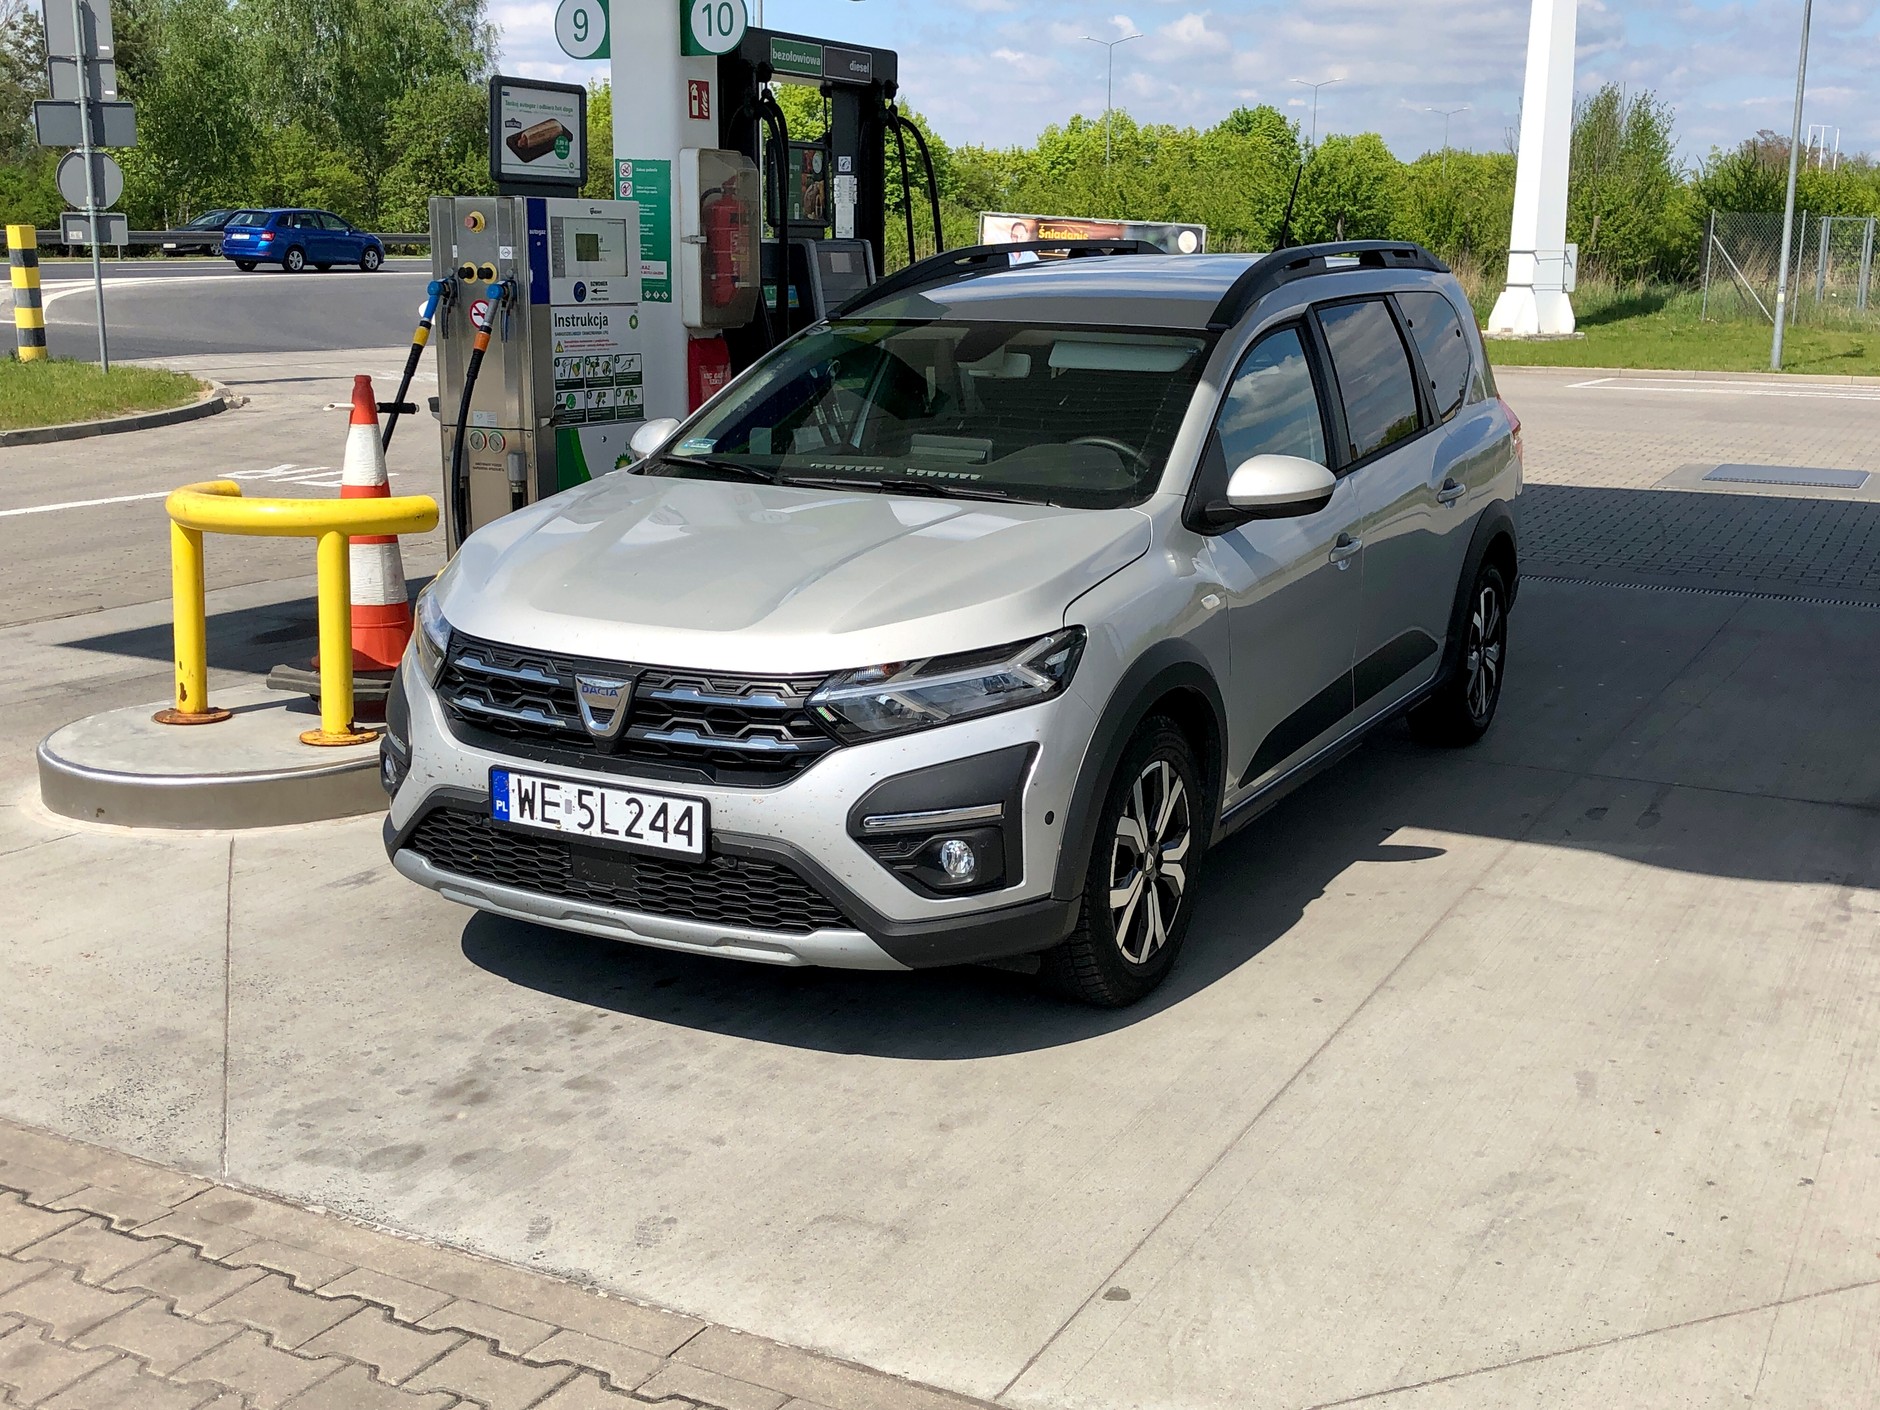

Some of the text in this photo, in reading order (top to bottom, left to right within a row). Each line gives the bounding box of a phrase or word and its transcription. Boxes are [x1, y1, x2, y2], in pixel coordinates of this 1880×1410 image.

[573, 8, 589, 42] 9
[702, 1, 734, 37] 10
[772, 48, 821, 66] bezołowiowa
[849, 60, 870, 73] diesel
[1038, 225, 1089, 240] Śniadanie
[554, 312, 609, 330] Instrukcja
[582, 685, 618, 697] DACIA
[496, 800, 508, 812] PL
[517, 778, 694, 847] WE 5L244
